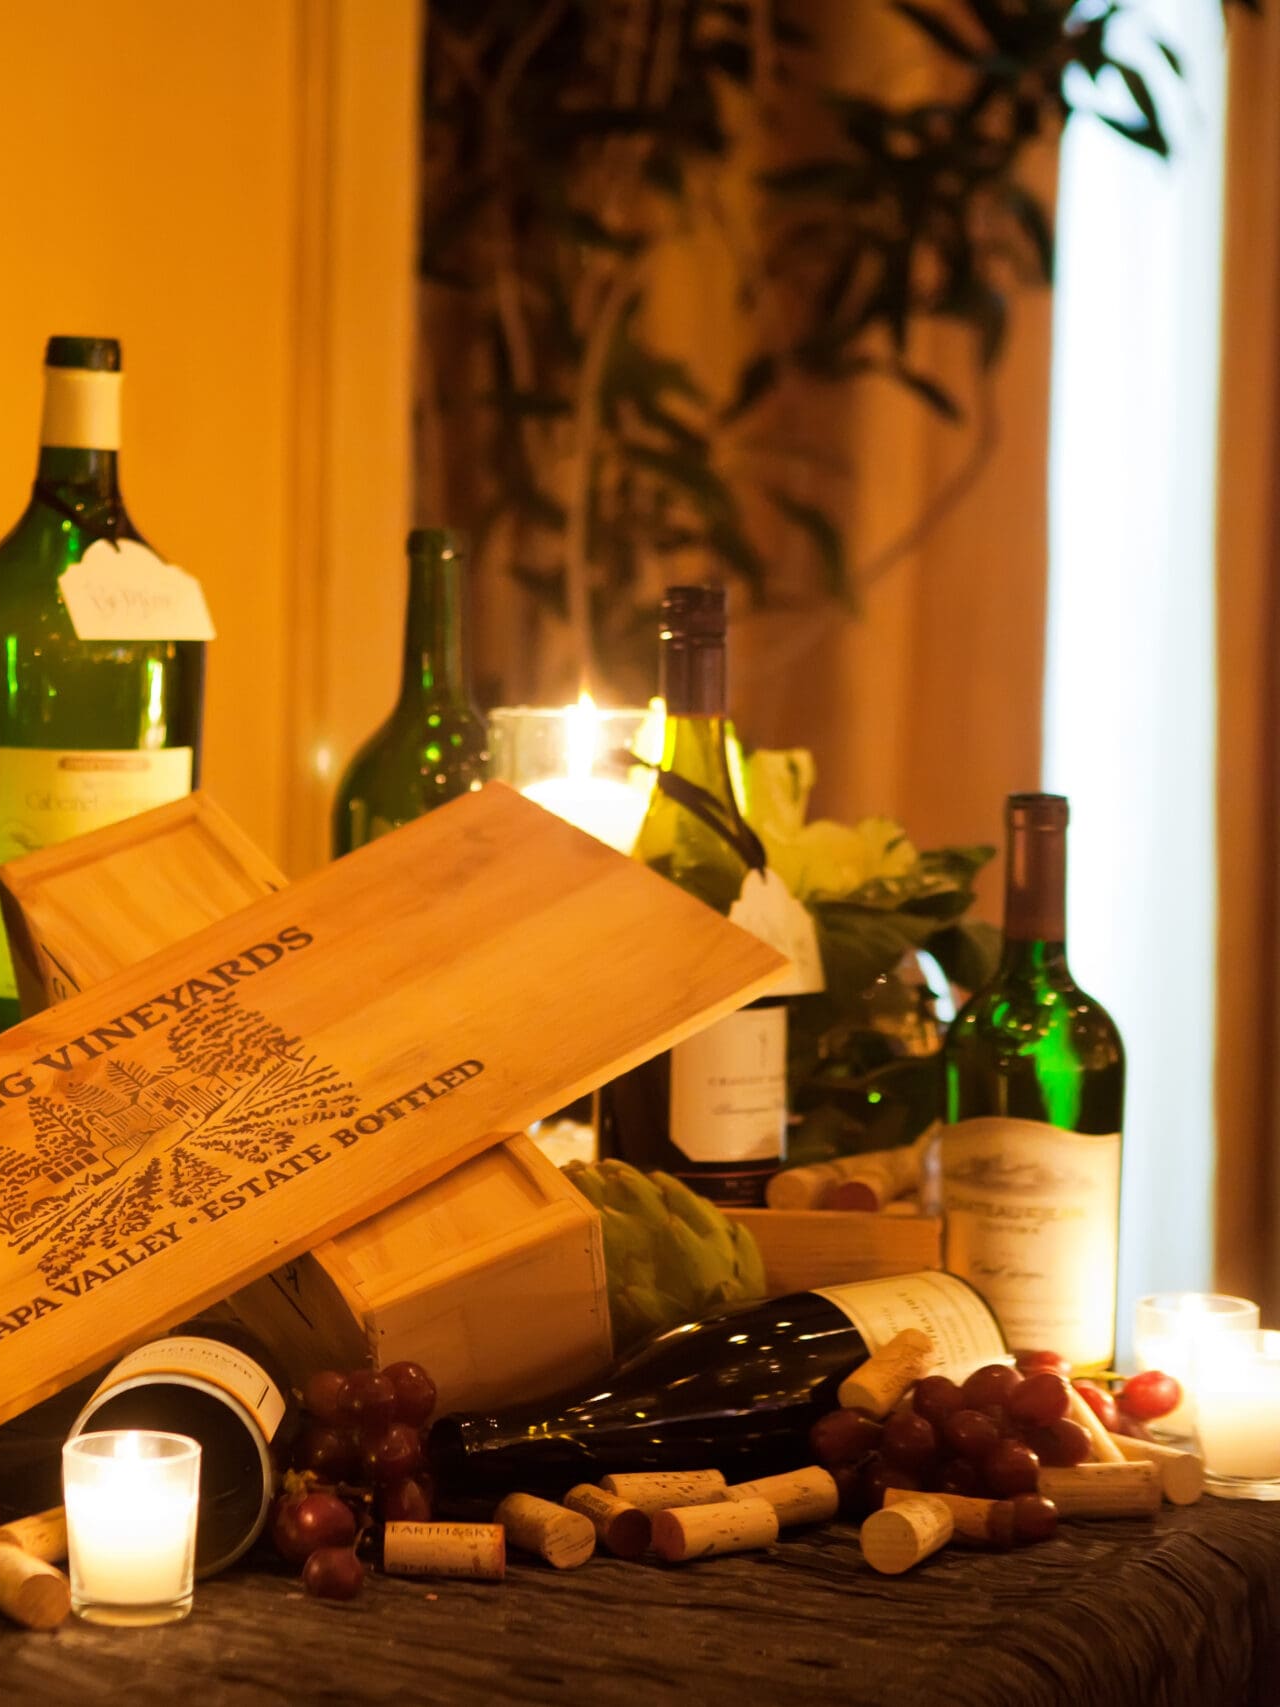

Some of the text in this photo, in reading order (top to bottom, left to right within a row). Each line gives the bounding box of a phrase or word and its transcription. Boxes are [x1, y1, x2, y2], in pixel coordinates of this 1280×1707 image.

[32, 925, 316, 1073] VINEYARDS
[54, 1225, 183, 1299] VALLEY
[203, 1146, 333, 1223] ESTATE
[334, 1059, 485, 1149] BOTTLED
